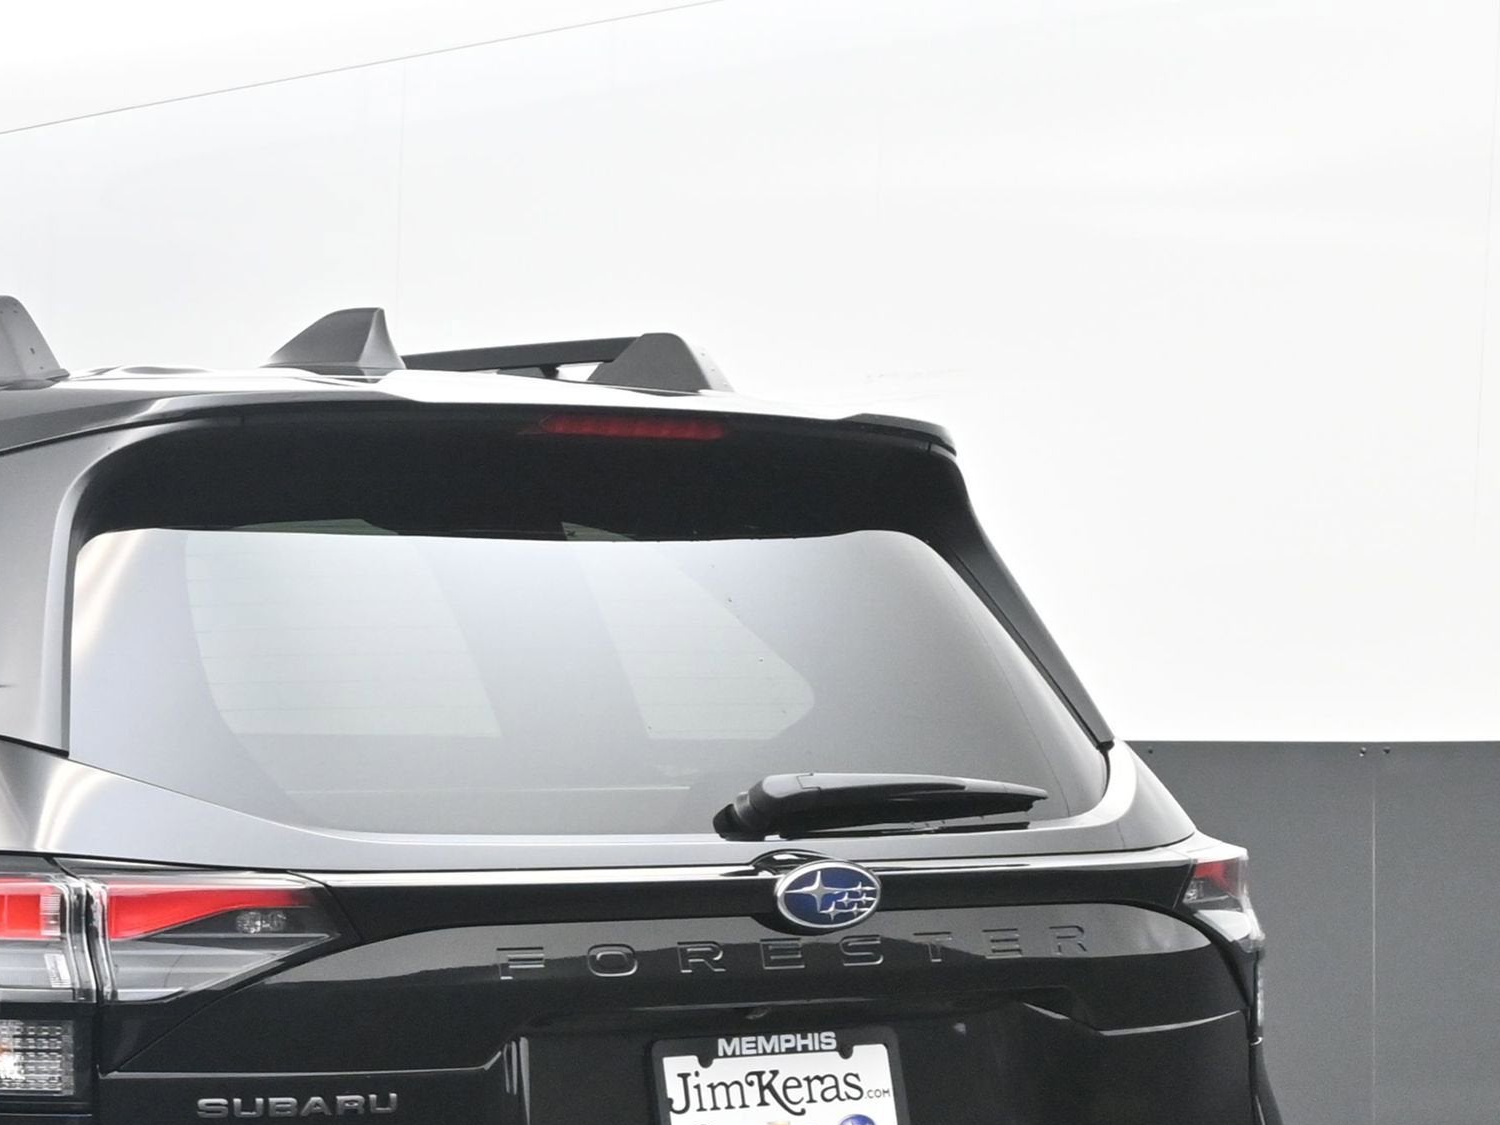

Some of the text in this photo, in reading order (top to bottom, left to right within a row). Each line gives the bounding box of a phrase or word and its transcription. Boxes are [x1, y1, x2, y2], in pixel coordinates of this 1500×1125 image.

[496, 924, 1088, 981] FORESTER
[717, 1031, 837, 1057] MEMPHIS
[197, 1092, 398, 1119] SUBARU
